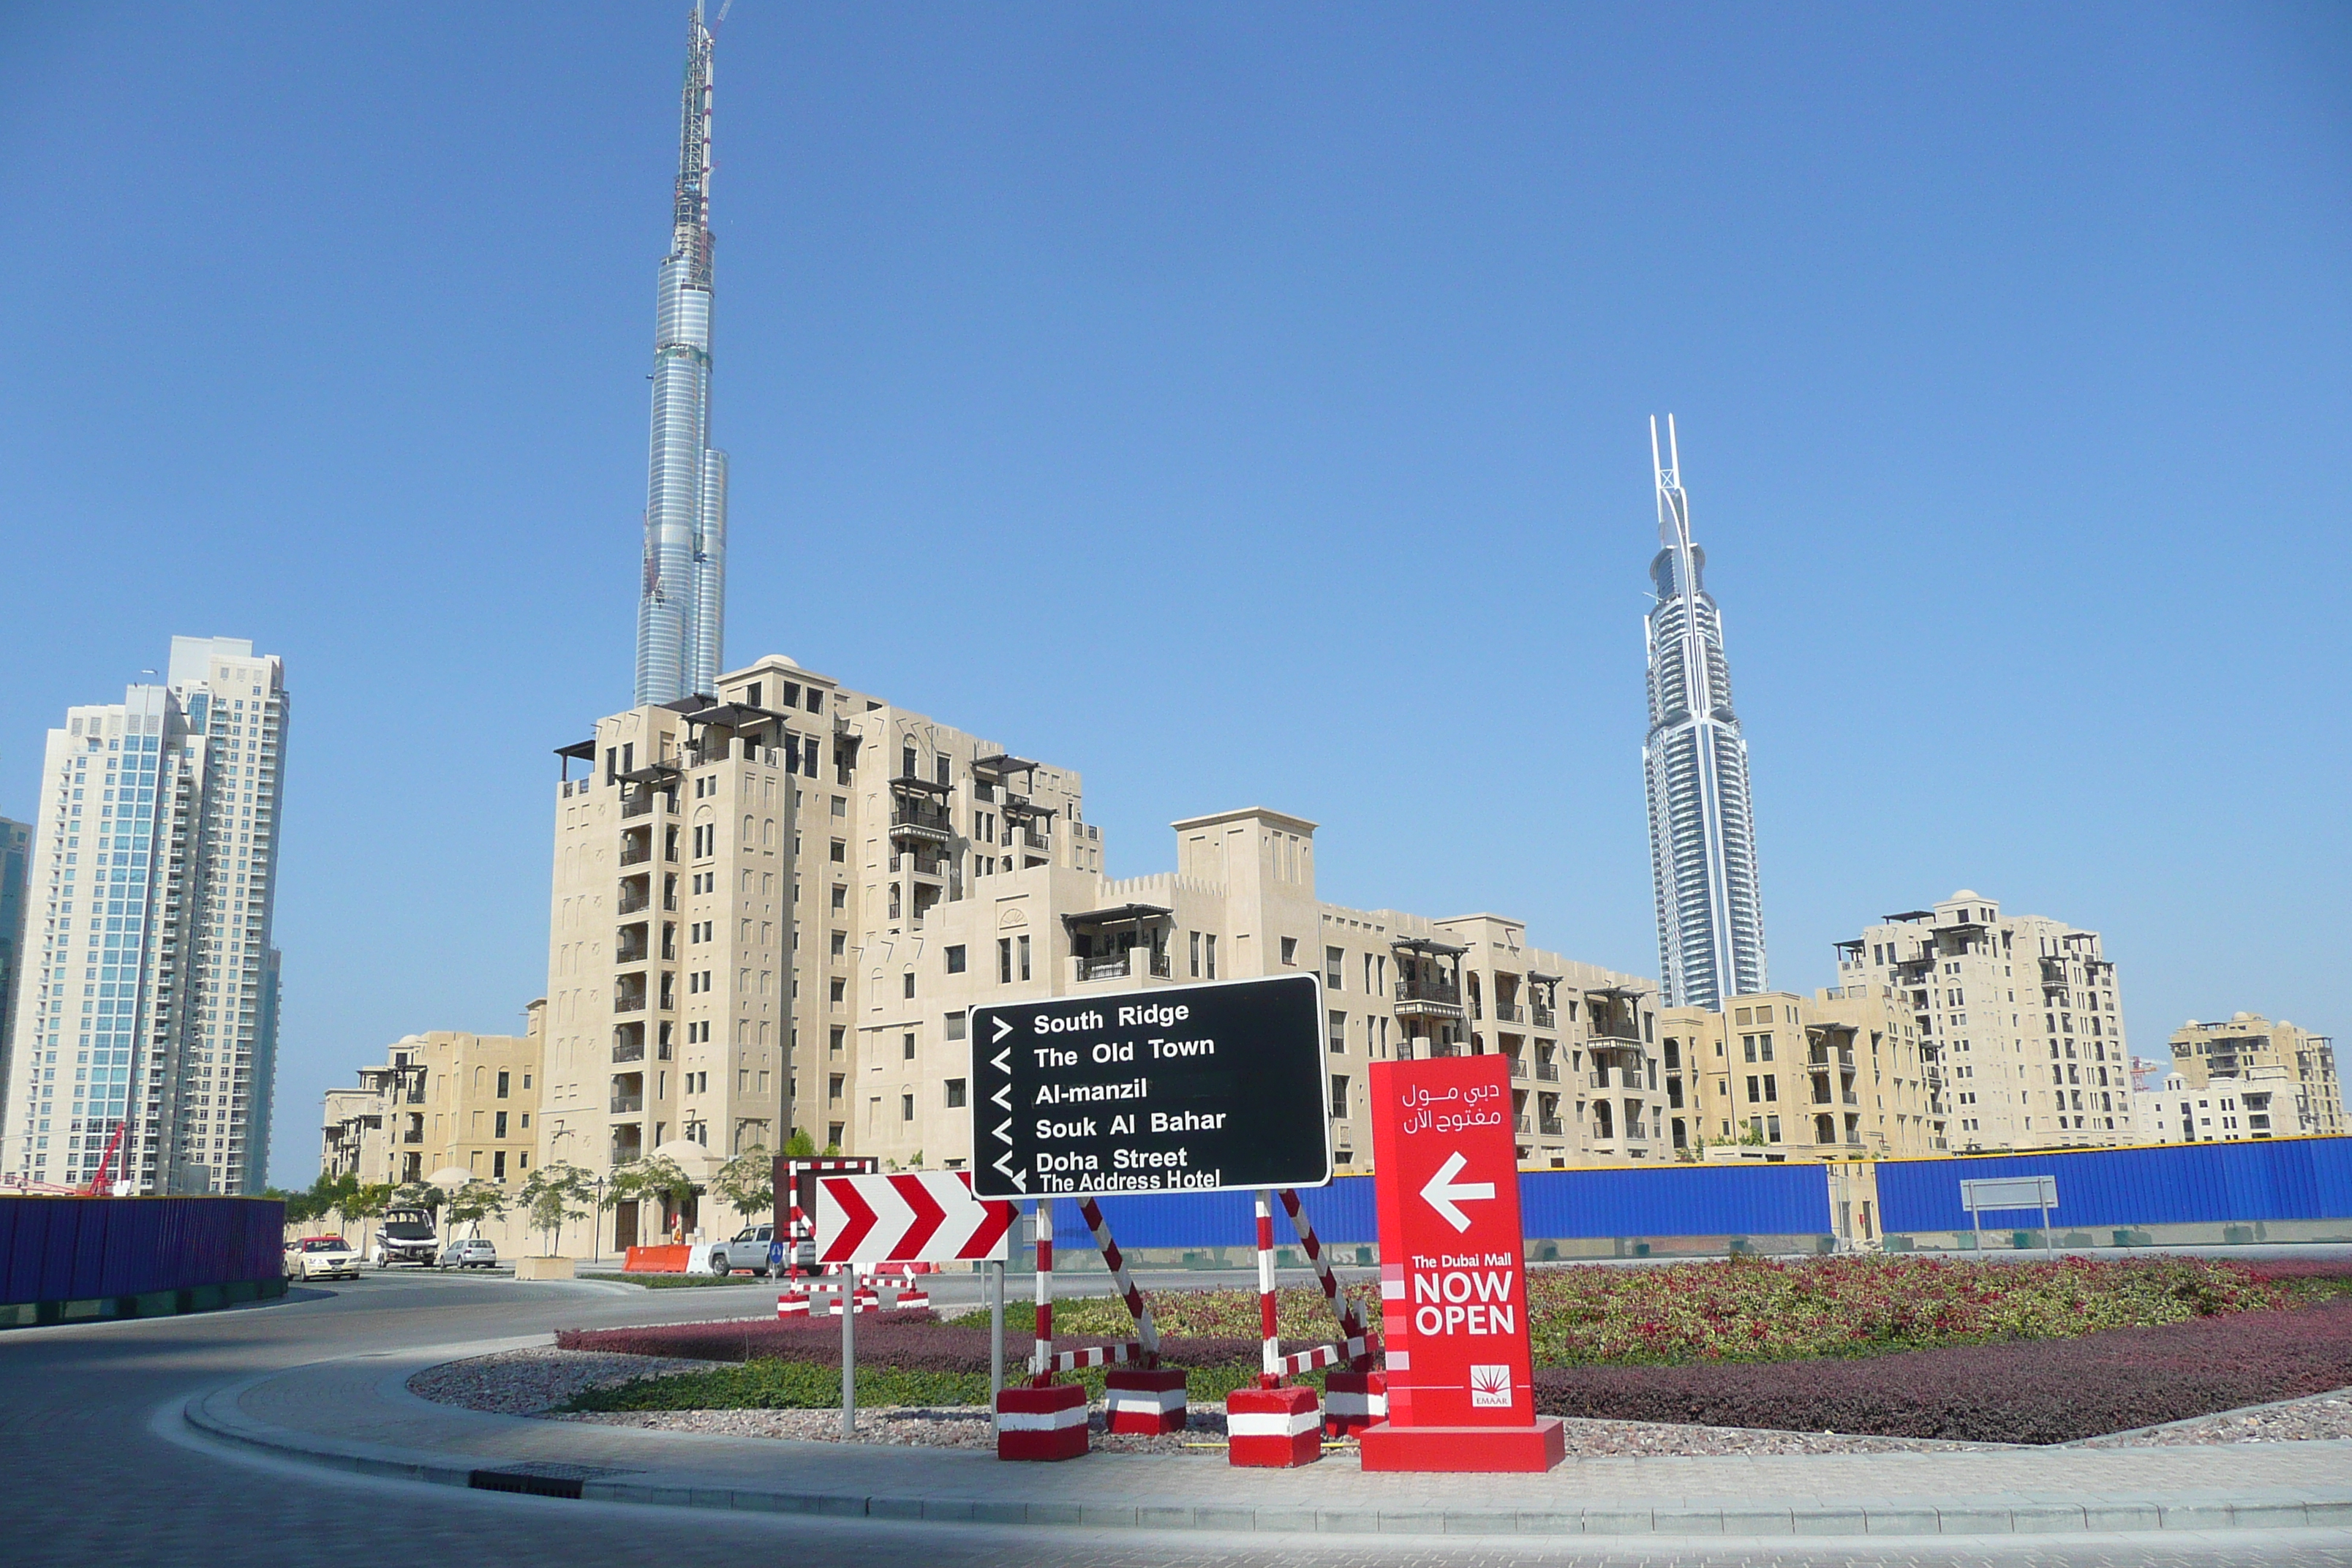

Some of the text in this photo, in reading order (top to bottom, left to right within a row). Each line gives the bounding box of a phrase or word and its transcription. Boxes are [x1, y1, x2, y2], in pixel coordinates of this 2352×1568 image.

[1034, 1003, 1189, 1034] South Ridge
[1034, 1036, 1215, 1068] The Old Town
[1036, 1078, 1147, 1105] Al-manzil
[1463, 1085, 1499, 1107] دبي
[1036, 1110, 1226, 1139] Souk Al Bahar
[1403, 1108, 1501, 1134] مفتوح الآن
[1036, 1147, 1188, 1172] Doha Street
[1040, 1169, 1221, 1192] The Address Hotel
[1411, 1252, 1512, 1269] The Dubai Mall
[1414, 1270, 1513, 1304] NOW
[1415, 1305, 1515, 1336] OPEN
[1476, 1397, 1508, 1405] EMAAR
